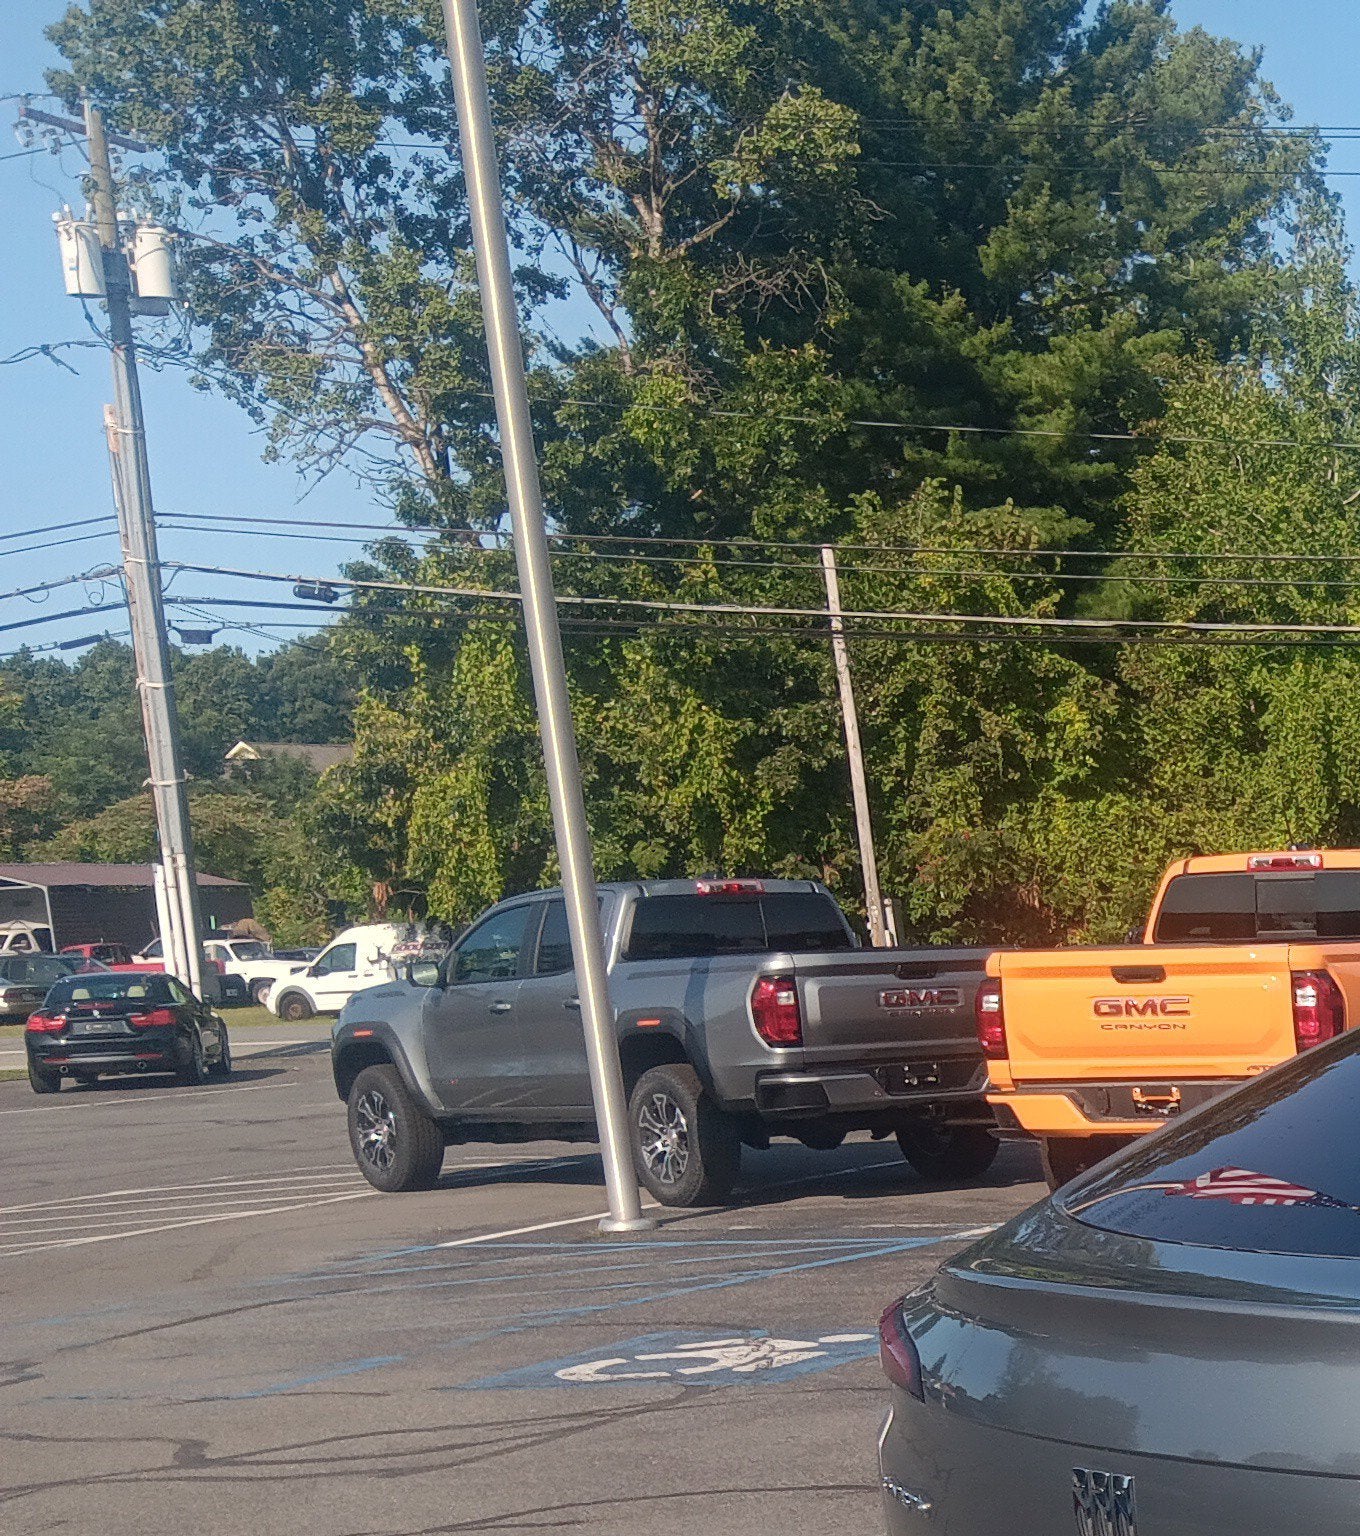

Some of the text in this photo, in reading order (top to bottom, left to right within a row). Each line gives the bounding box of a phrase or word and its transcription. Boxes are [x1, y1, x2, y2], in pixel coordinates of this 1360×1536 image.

[881, 988, 960, 1008] GMC
[1093, 998, 1190, 1018] GMC
[1100, 1023, 1187, 1031] CANYON
